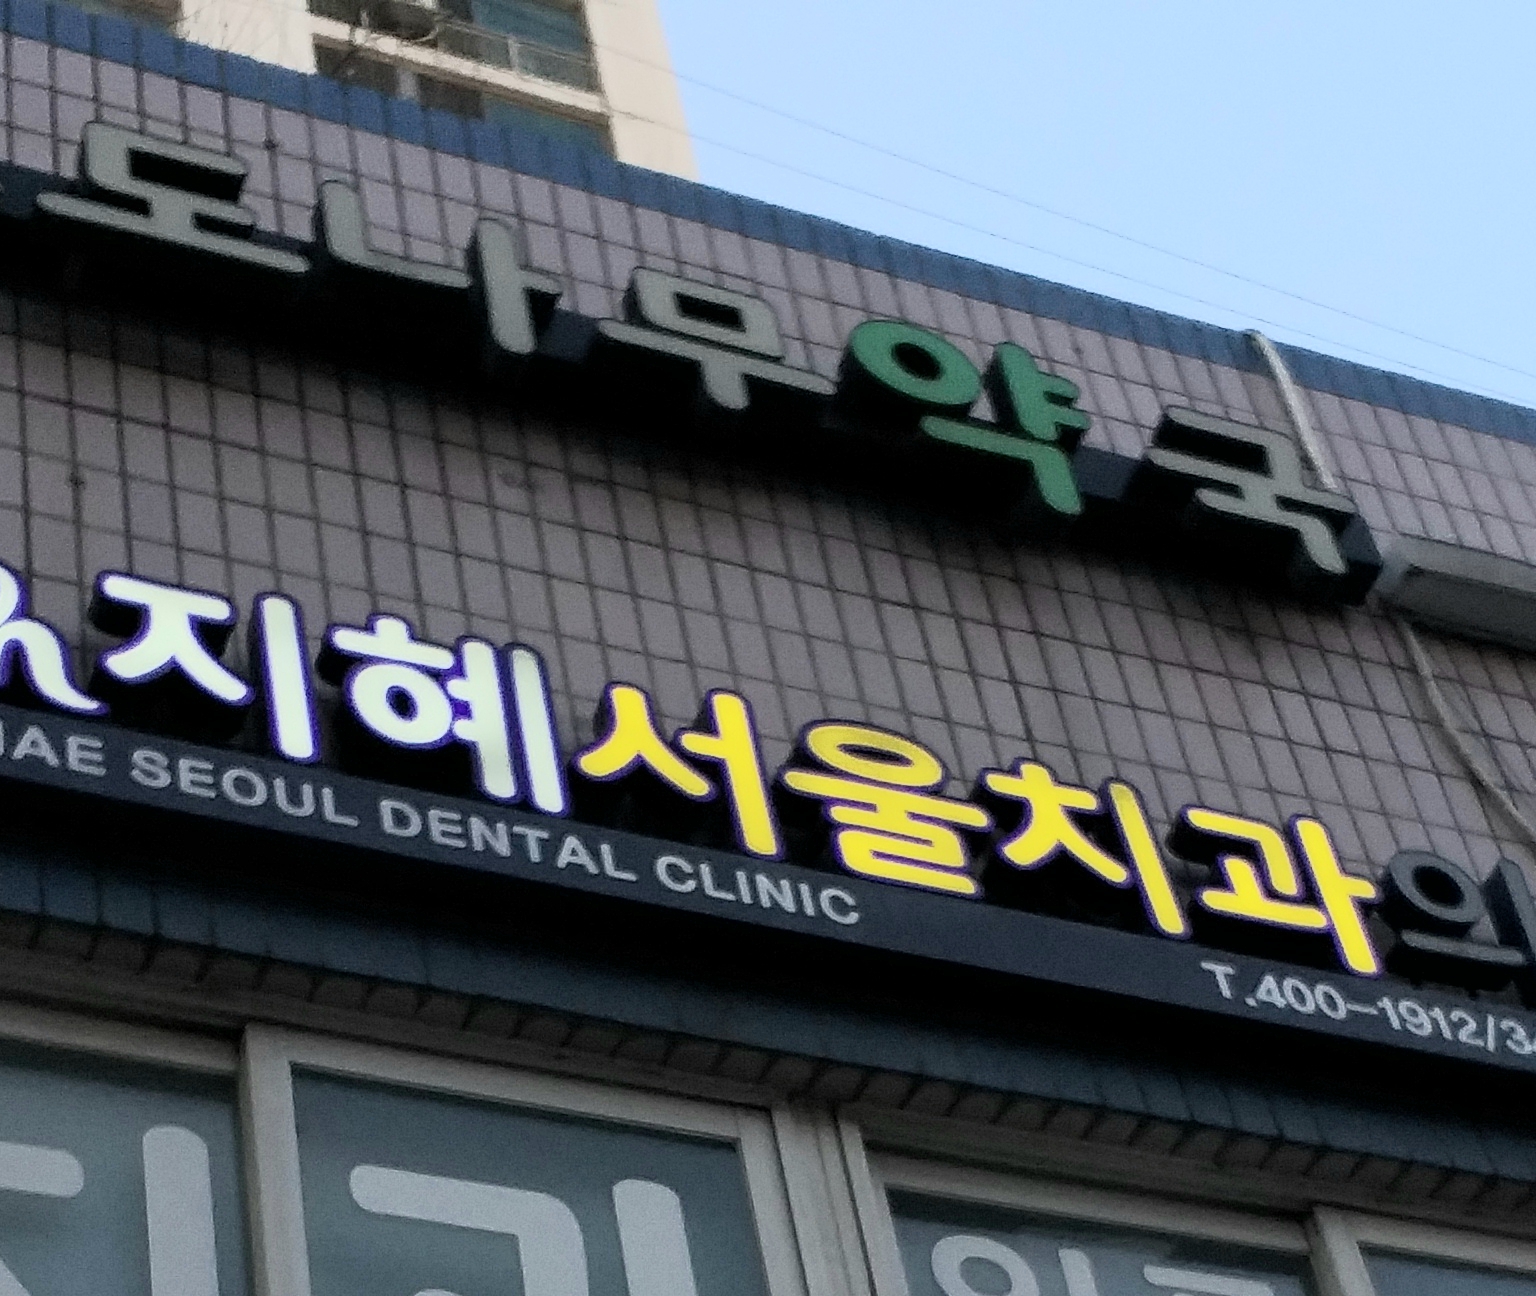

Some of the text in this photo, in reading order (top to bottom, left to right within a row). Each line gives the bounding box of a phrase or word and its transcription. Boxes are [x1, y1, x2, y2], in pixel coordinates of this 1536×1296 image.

[129, 749, 359, 828] SEOUL
[378, 797, 639, 883] DENTAL
[654, 853, 862, 927] CLINIC
